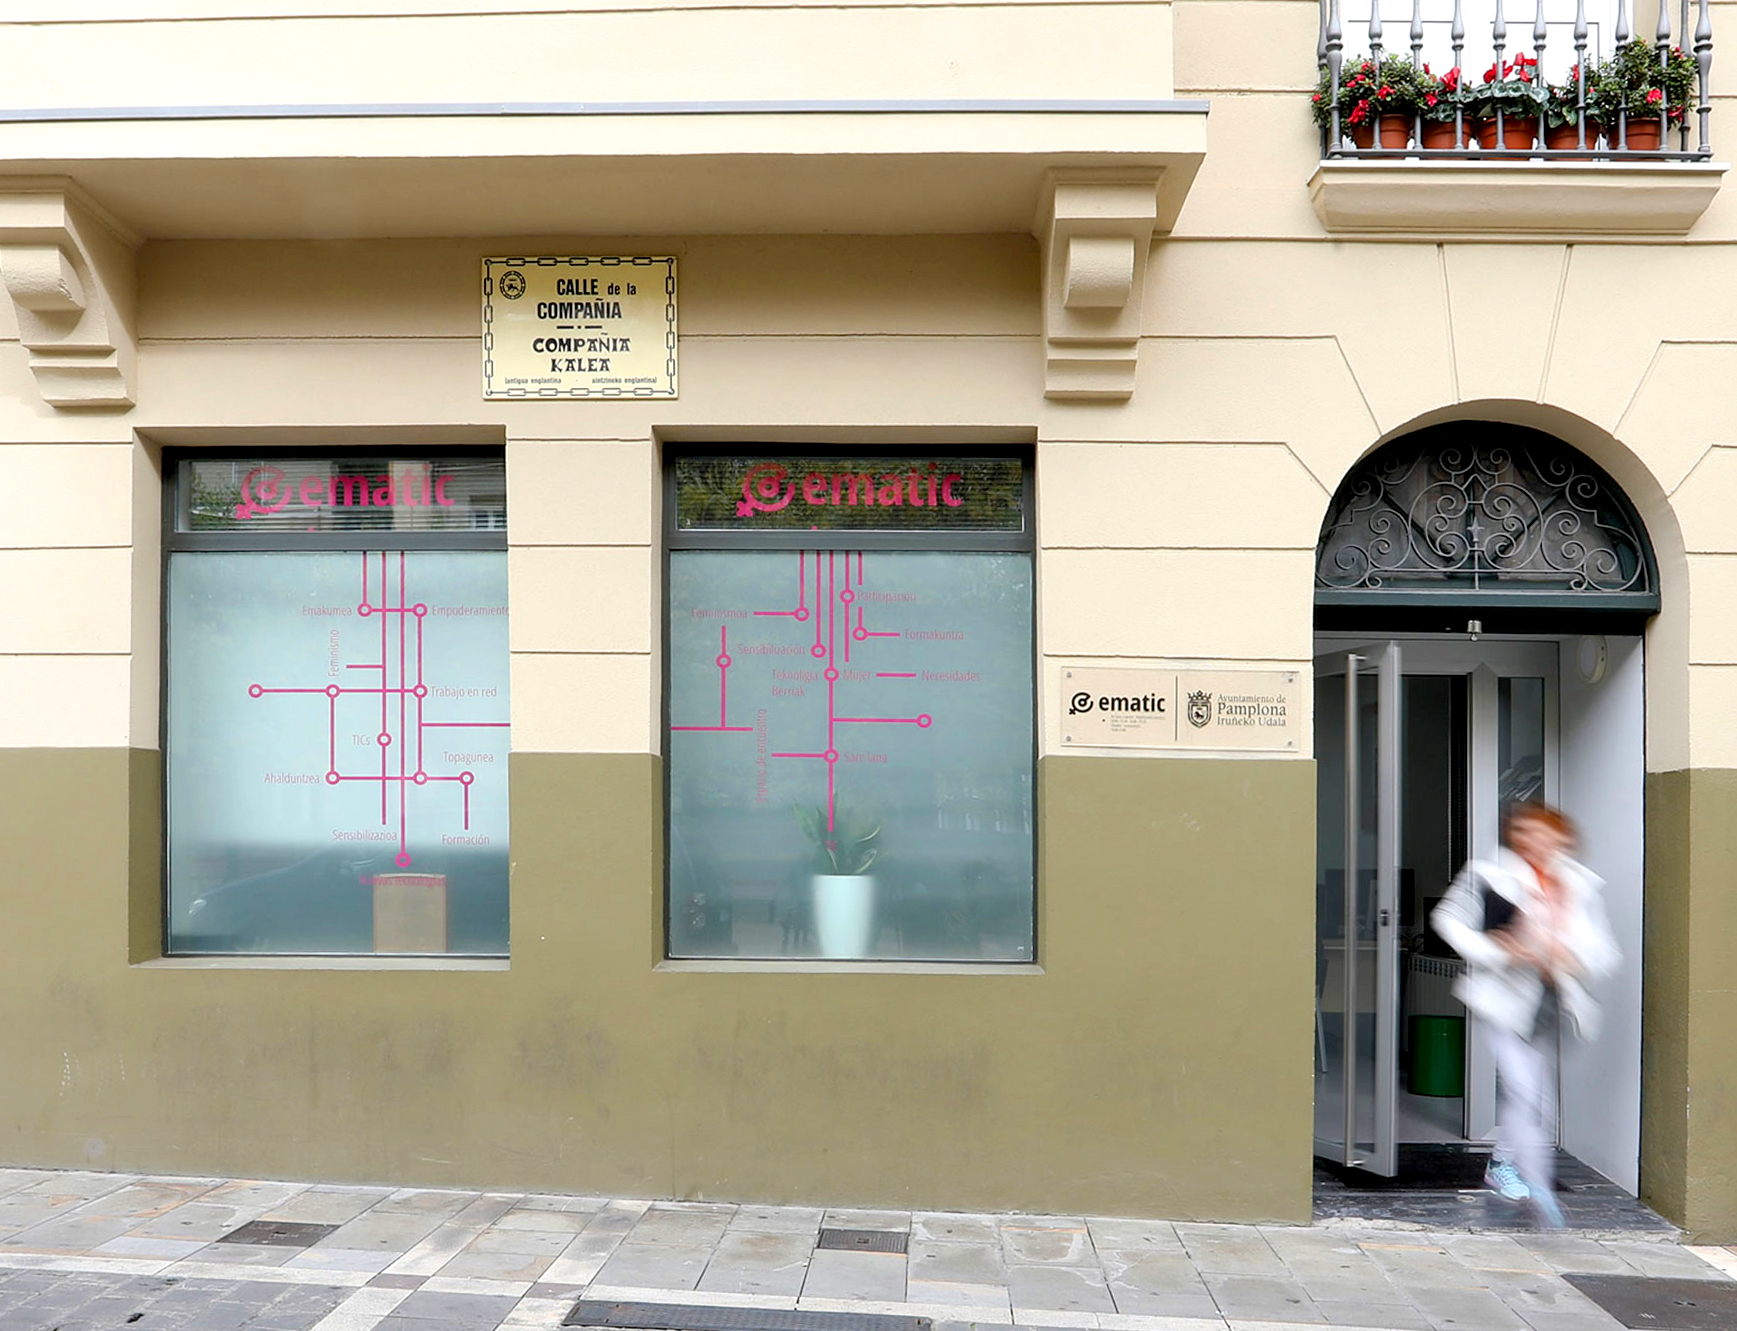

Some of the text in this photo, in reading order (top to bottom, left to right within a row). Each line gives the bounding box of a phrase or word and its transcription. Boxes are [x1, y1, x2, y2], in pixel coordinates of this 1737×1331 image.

[557, 278, 637, 296] CALLE de la
[537, 298, 622, 320] COMPAÑIA
[532, 332, 631, 353] COMPAÑIA
[550, 357, 611, 373] KALEA
[300, 464, 455, 507] ematic
[802, 462, 963, 506] ematic
[302, 604, 352, 617] Emakumea
[328, 629, 340, 677] Feminismo
[922, 669, 982, 682] Necesidades
[430, 685, 497, 699] Trabajo en red
[1218, 694, 1286, 703] Ayuntamiento de
[1099, 693, 1166, 712] ematic
[1218, 702, 1286, 718] Pamplona
[1217, 716, 1286, 726] Iruñeko Udala
[352, 734, 371, 746] TICs
[443, 751, 494, 765] Topagunea
[264, 773, 320, 784] Ahalduntzea
[332, 829, 398, 841] Sensibilizazioa
[442, 833, 490, 846] Formación
